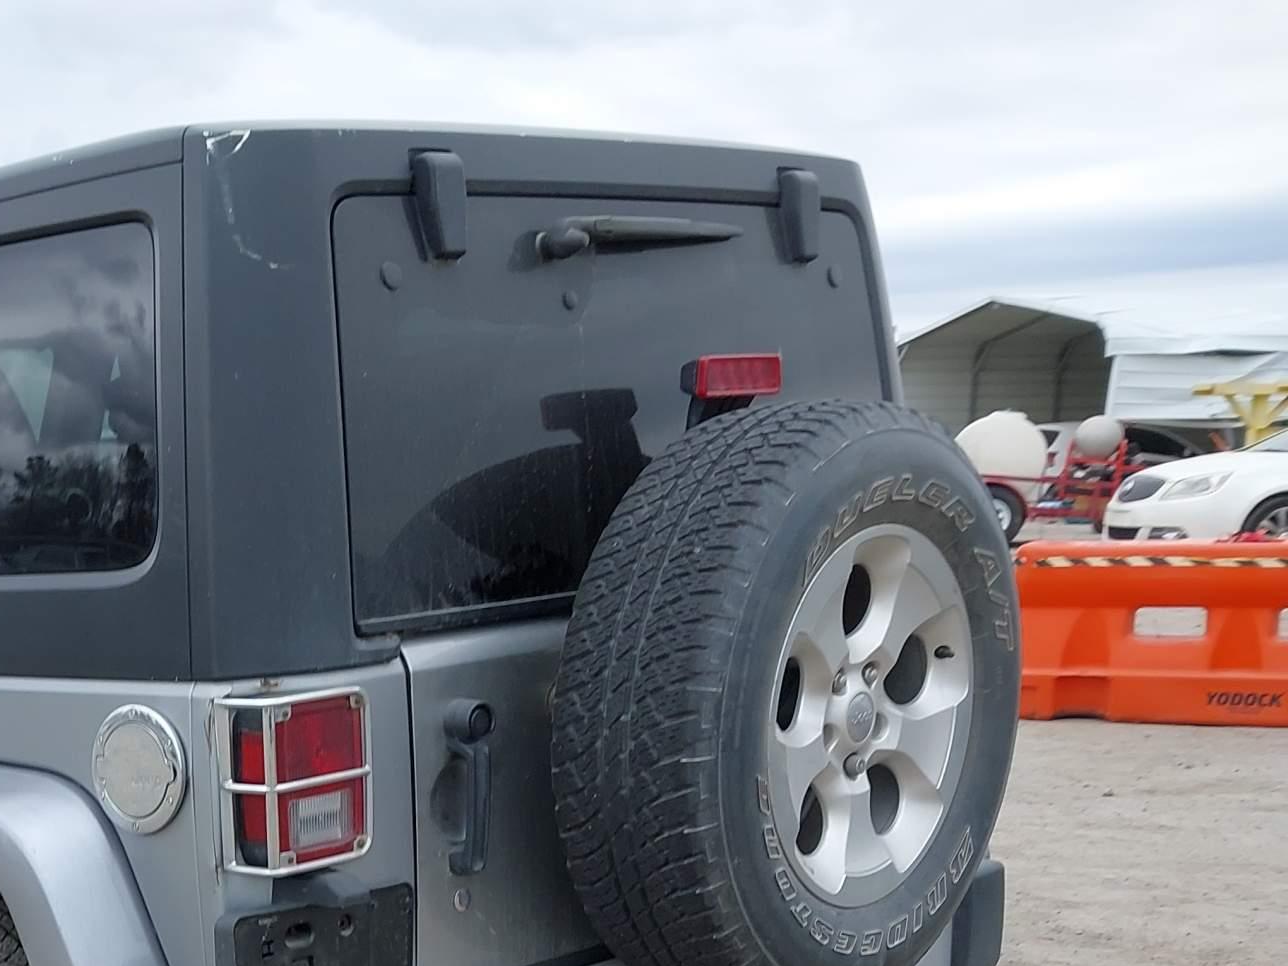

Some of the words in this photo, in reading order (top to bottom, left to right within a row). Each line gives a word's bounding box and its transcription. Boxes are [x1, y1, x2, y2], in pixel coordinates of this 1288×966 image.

[801, 473, 976, 588] DUELER
[973, 547, 1014, 652] A/T
[1207, 690, 1286, 708] YODOCK
[756, 774, 974, 956] BRIDGESTONE
